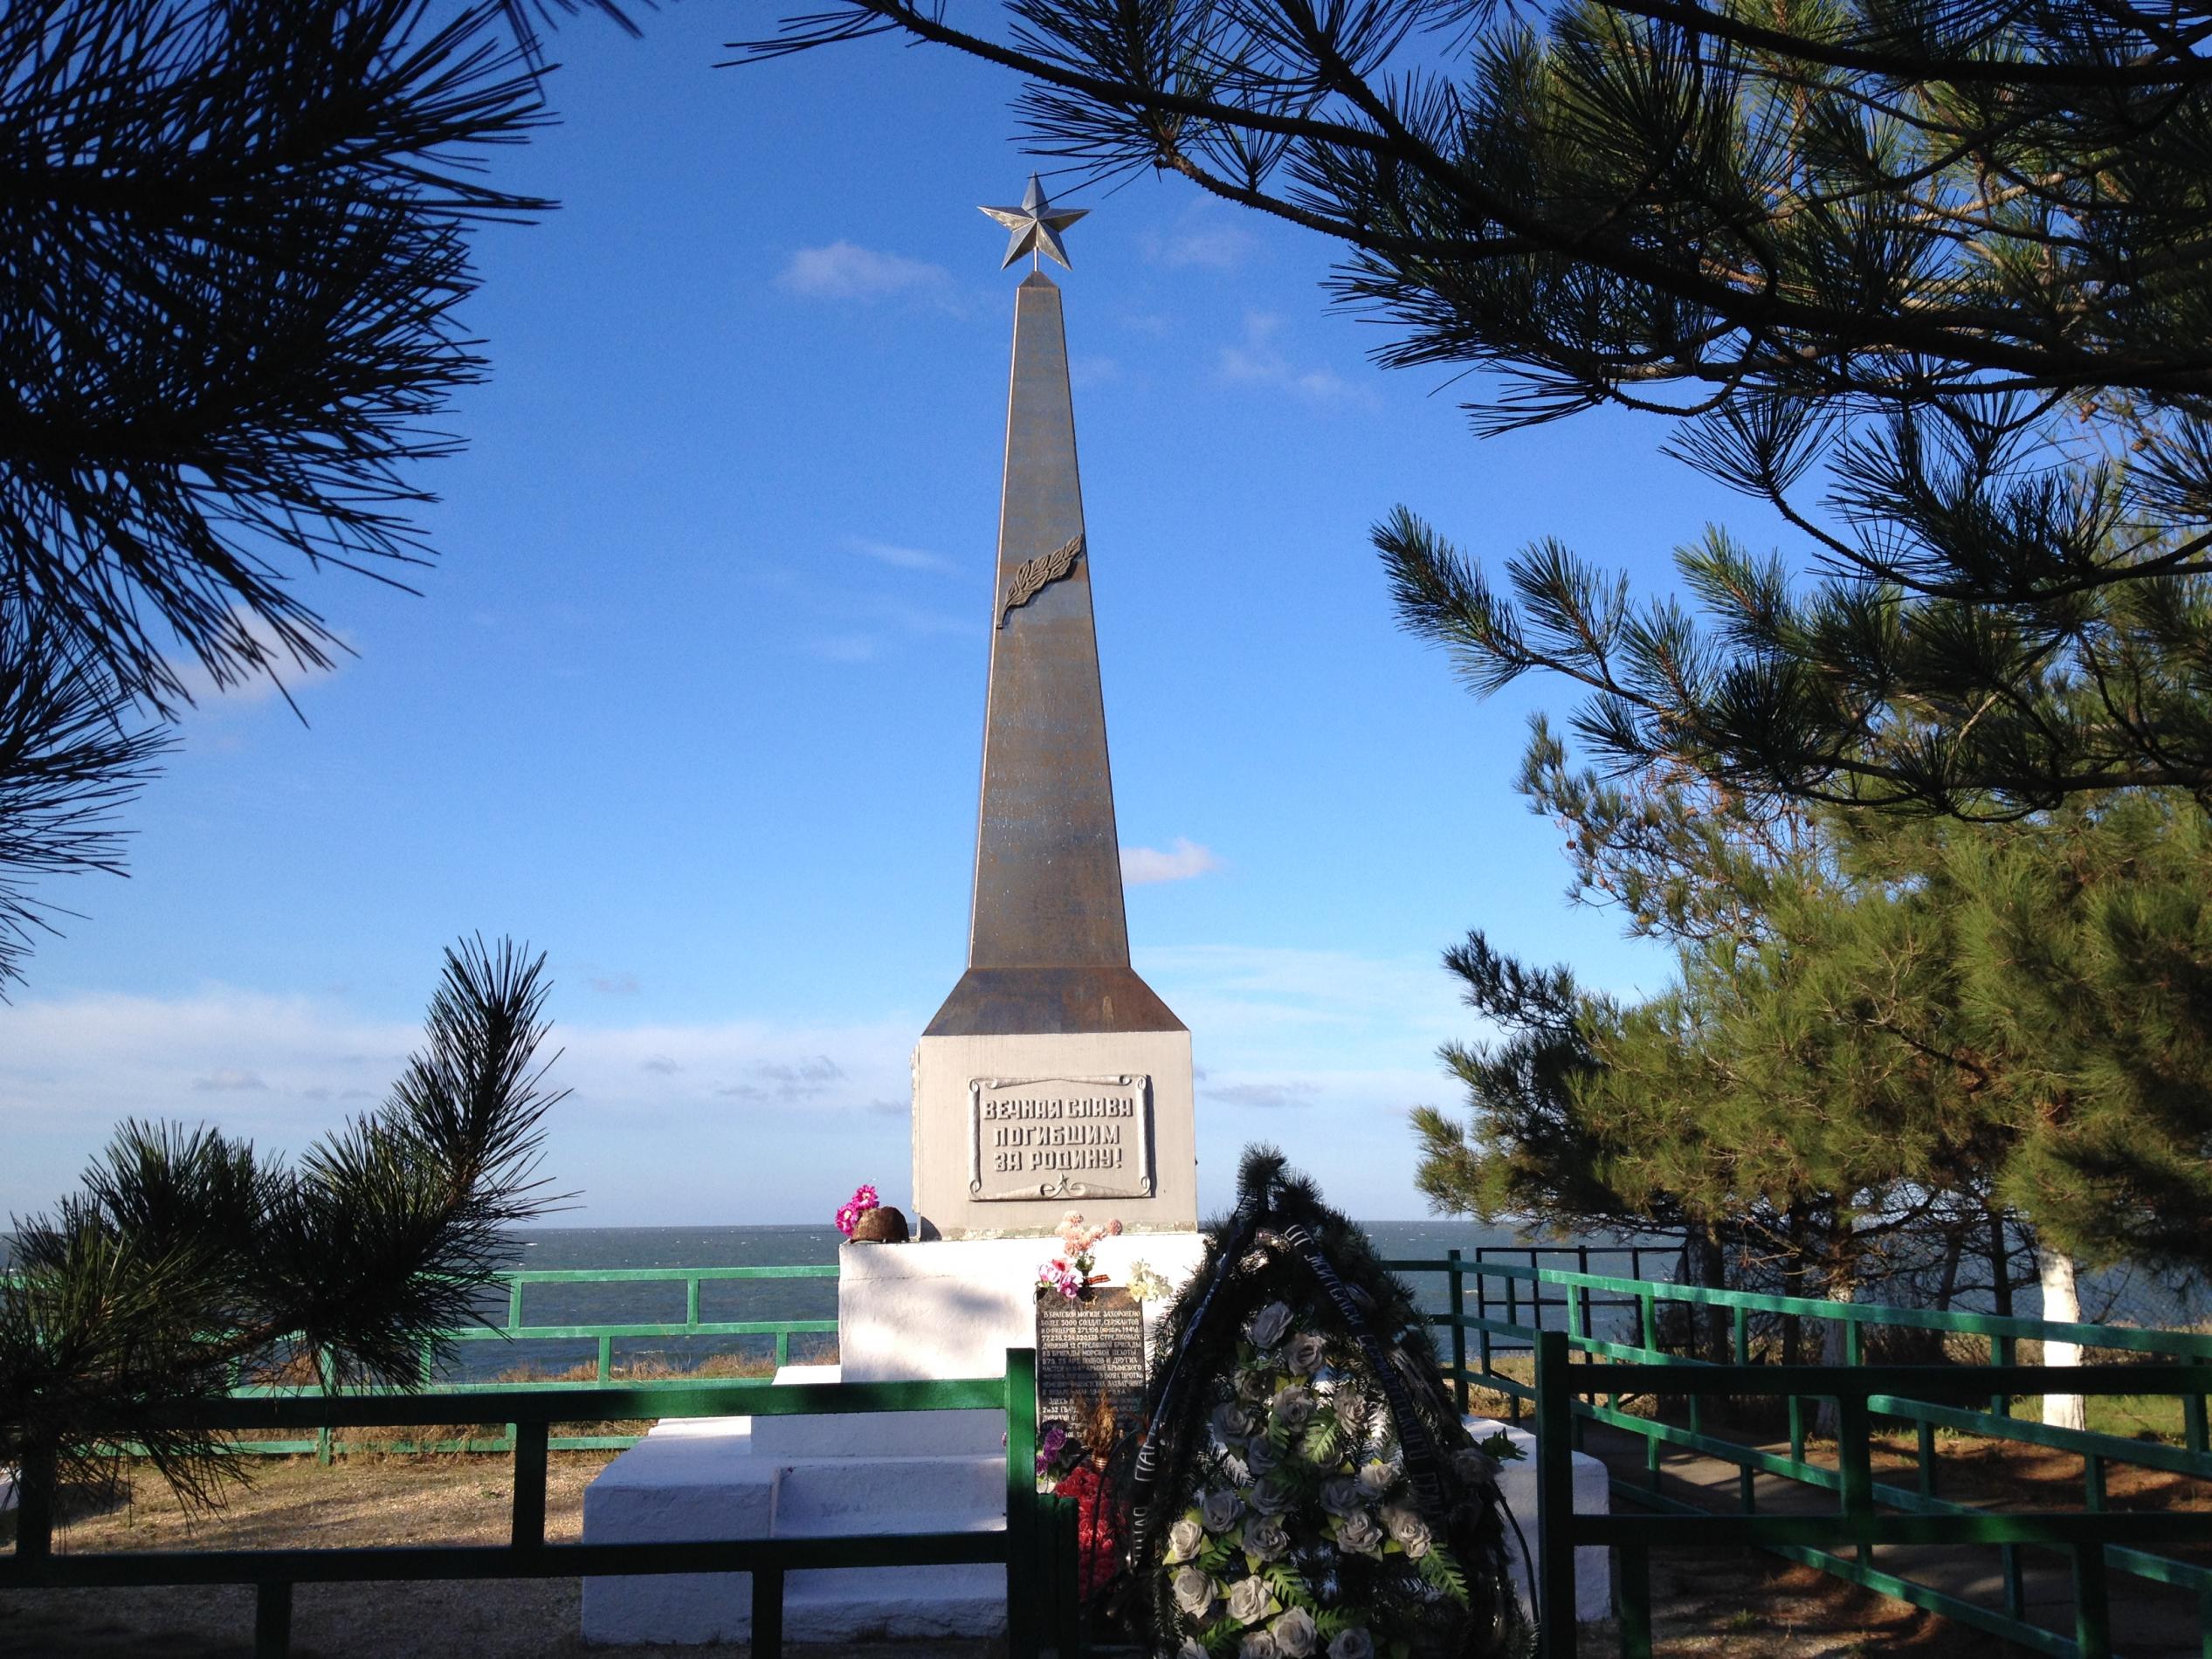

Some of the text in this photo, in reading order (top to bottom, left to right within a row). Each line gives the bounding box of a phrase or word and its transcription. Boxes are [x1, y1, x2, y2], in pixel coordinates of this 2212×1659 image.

[982, 1098, 1134, 1120] ВЕЧНАЯ СЛАВА
[993, 1125, 1120, 1146] ПОГИБШИМ
[994, 1148, 1122, 1172] ЗА РОДИНУ!
[1285, 1223, 1314, 1247] ОТ
